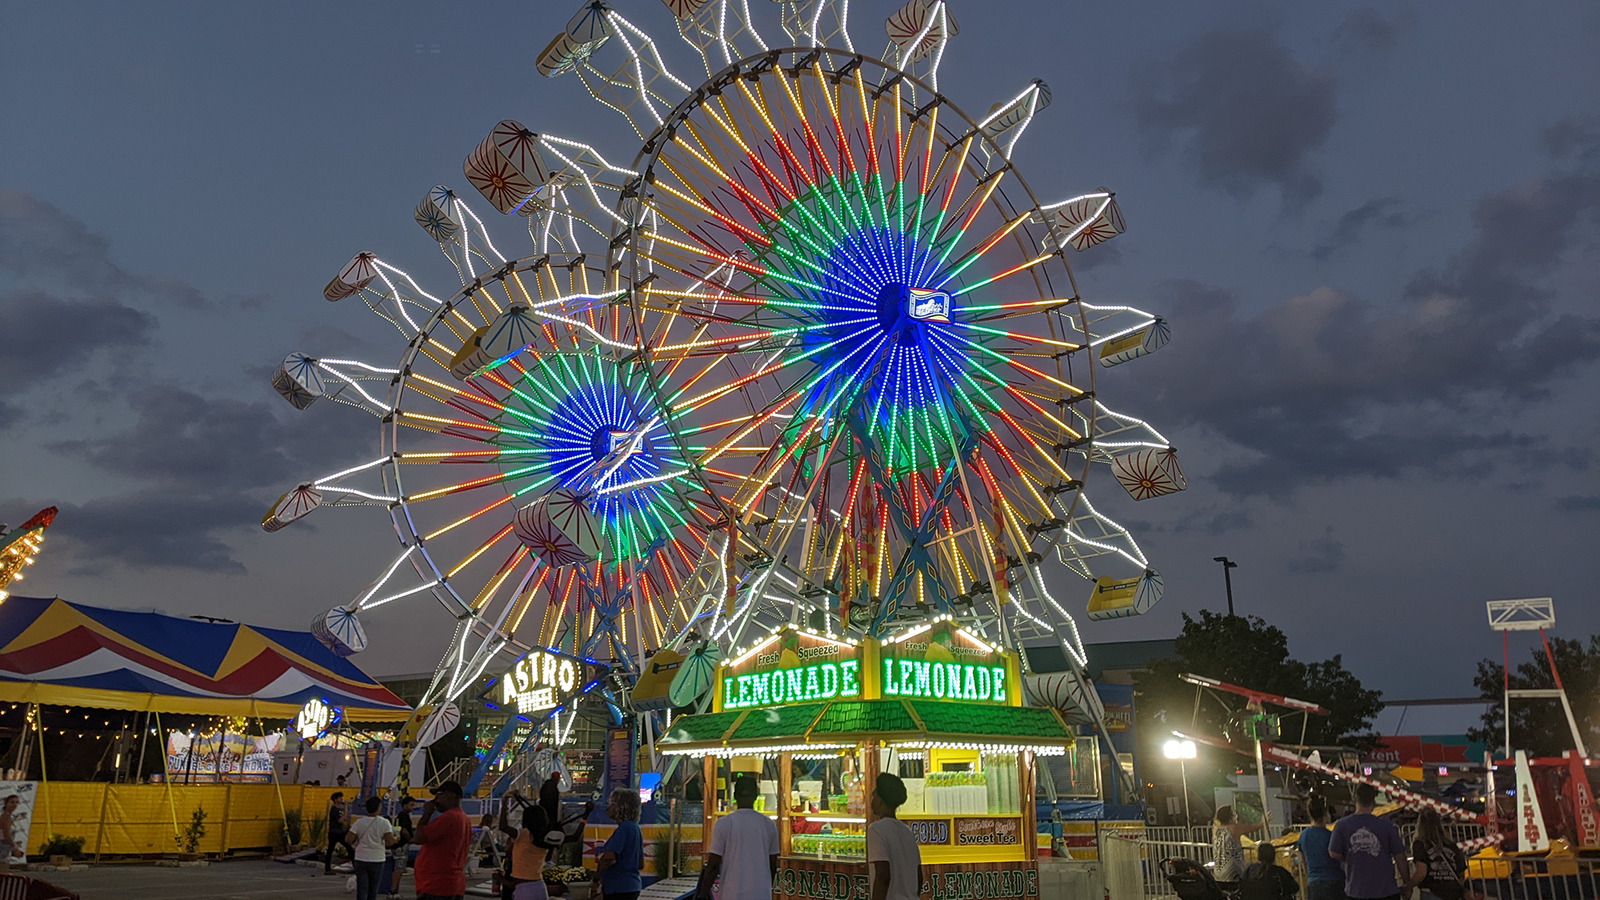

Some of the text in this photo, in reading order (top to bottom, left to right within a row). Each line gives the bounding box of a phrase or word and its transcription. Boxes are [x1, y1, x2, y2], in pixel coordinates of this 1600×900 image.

[757, 645, 839, 666] Fresh Squeezed
[905, 641, 987, 656] Fresh Squeezed
[503, 651, 575, 705] ASTRO
[723, 660, 859, 709] LEMONADE
[884, 658, 1006, 702] LEMONADE
[167, 755, 204, 771] FUNEL
[911, 821, 948, 844] COLD
[959, 832, 1017, 844] Sweet Tea
[931, 869, 1038, 900] LEMONADE
